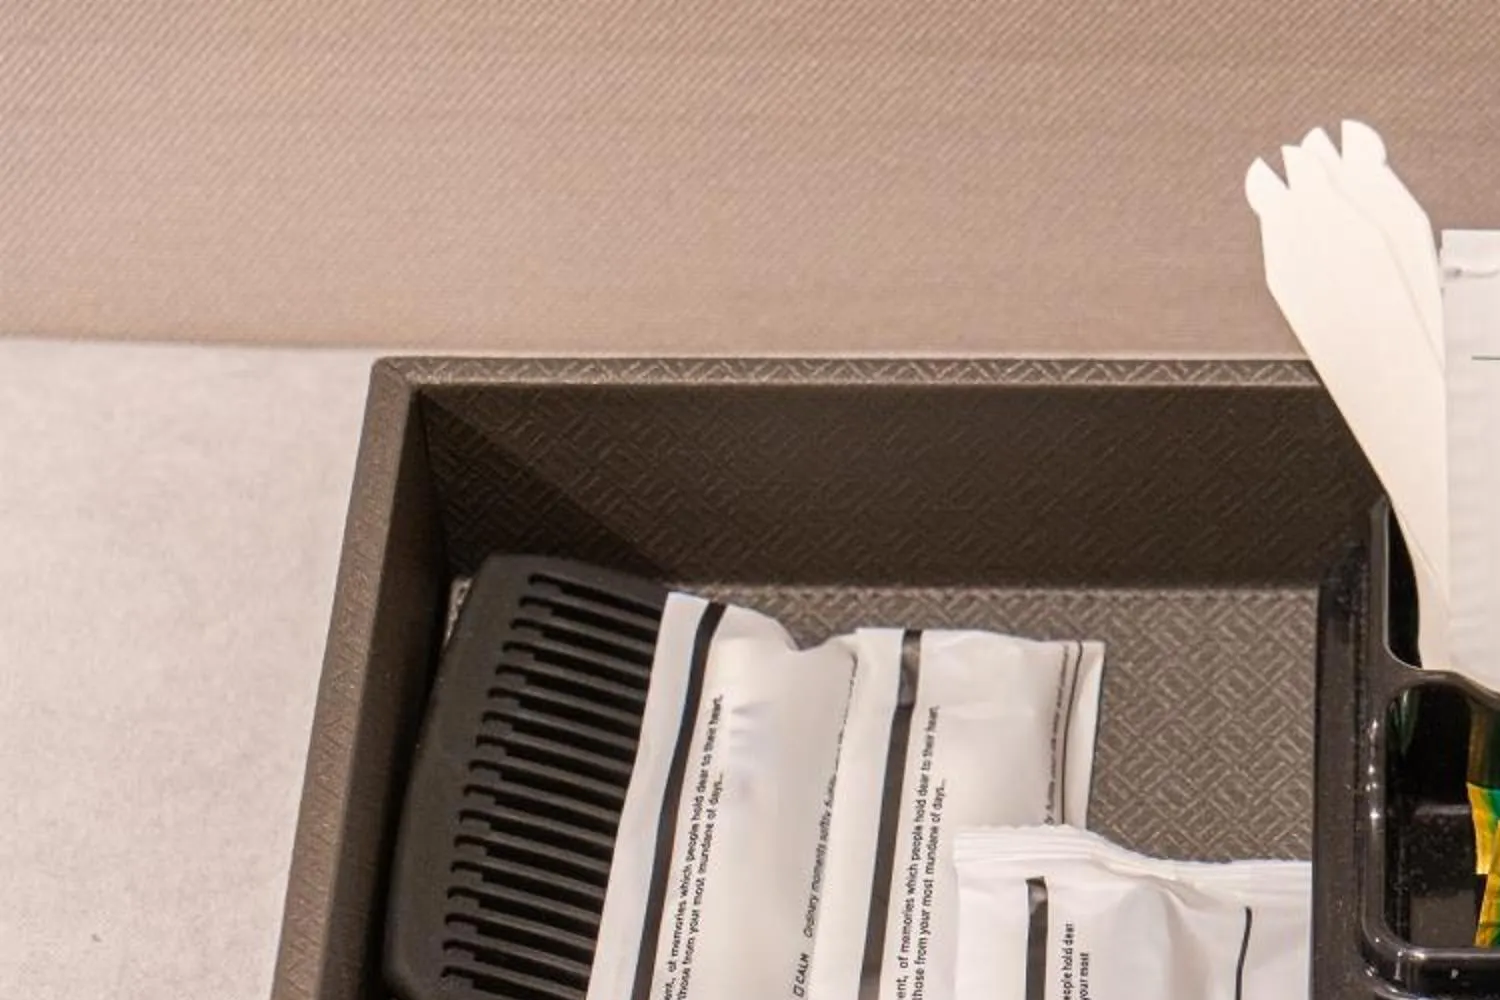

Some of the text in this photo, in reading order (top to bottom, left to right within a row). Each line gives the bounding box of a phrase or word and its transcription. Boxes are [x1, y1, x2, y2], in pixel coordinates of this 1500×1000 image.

[920, 759, 931, 771] to
[917, 773, 929, 797] dear
[913, 799, 927, 822] hold
[929, 811, 941, 823] of
[911, 825, 923, 861] people
[925, 825, 939, 875] mundane
[905, 863, 918, 895] which
[921, 878, 934, 907] most
[900, 898, 914, 953] memories
[919, 909, 931, 935] your
[897, 955, 909, 969] of
[914, 937, 928, 965] from
